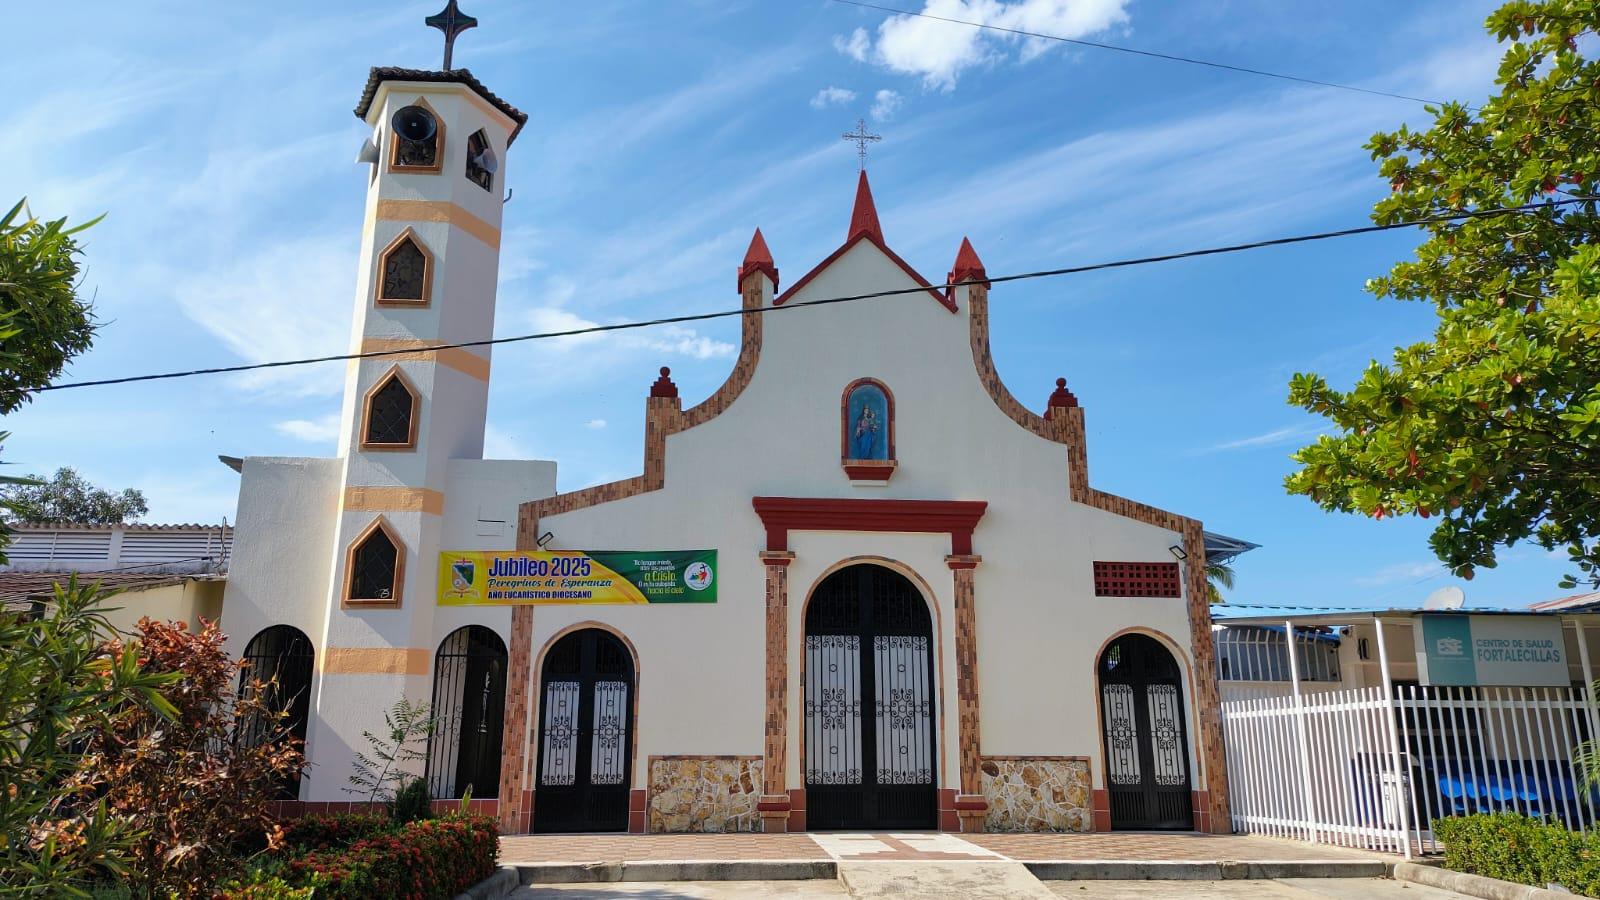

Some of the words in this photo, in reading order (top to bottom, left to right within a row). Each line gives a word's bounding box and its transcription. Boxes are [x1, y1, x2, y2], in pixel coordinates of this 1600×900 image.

[488, 557, 547, 577] Jubileo
[551, 557, 591, 577] 2025
[488, 578, 541, 588] Peregrinos
[544, 578, 556, 587] de
[560, 578, 612, 588] Esperanza
[488, 590, 502, 599] AÑO
[504, 590, 551, 599] EUCARÍSTICO
[552, 590, 592, 599] DIOCESANO
[1476, 640, 1510, 648] CENTRO
[1513, 640, 1523, 648] DE
[1526, 640, 1553, 648] SALUD
[1477, 649, 1560, 662] FORTALECILLAS
